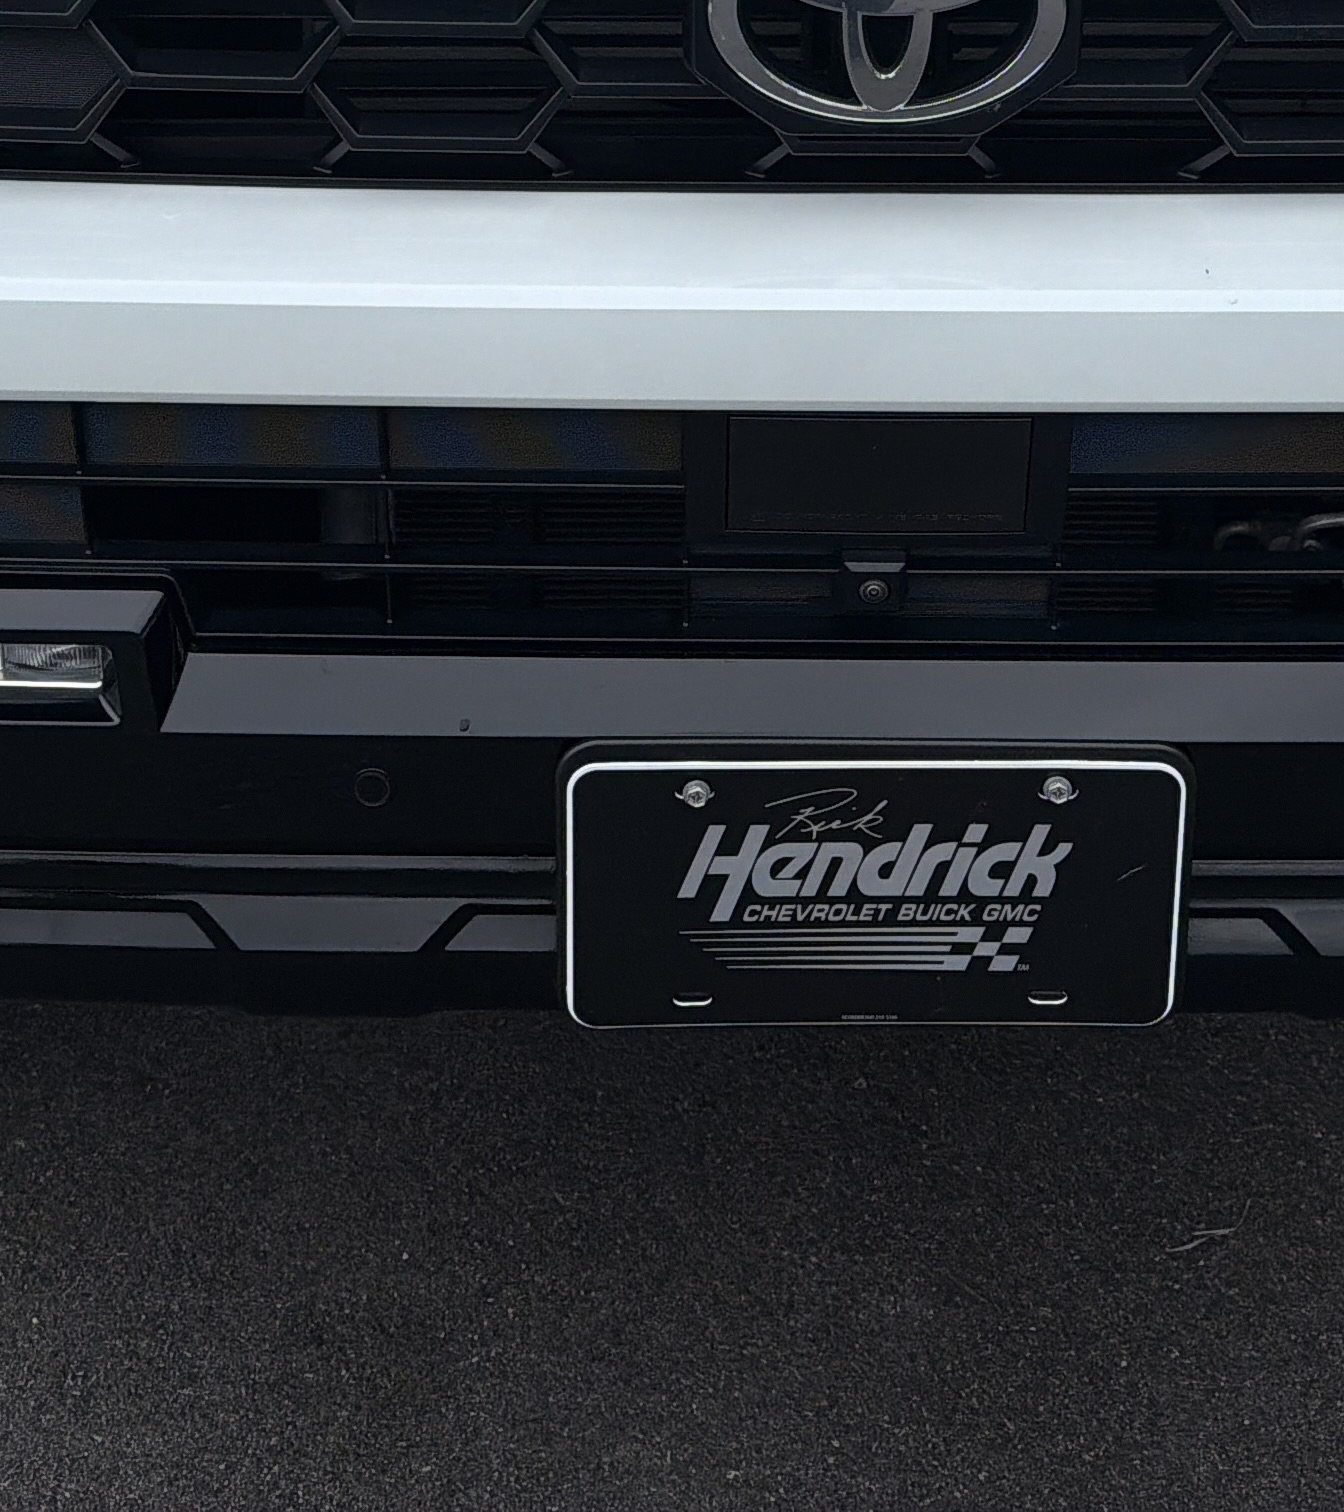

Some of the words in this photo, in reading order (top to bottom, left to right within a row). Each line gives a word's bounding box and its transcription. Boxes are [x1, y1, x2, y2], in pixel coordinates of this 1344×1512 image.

[676, 823, 1075, 923] Hendrick
[743, 903, 893, 923] CHEVROLET
[896, 903, 974, 922] BUICK
[982, 903, 1042, 922] GMC
